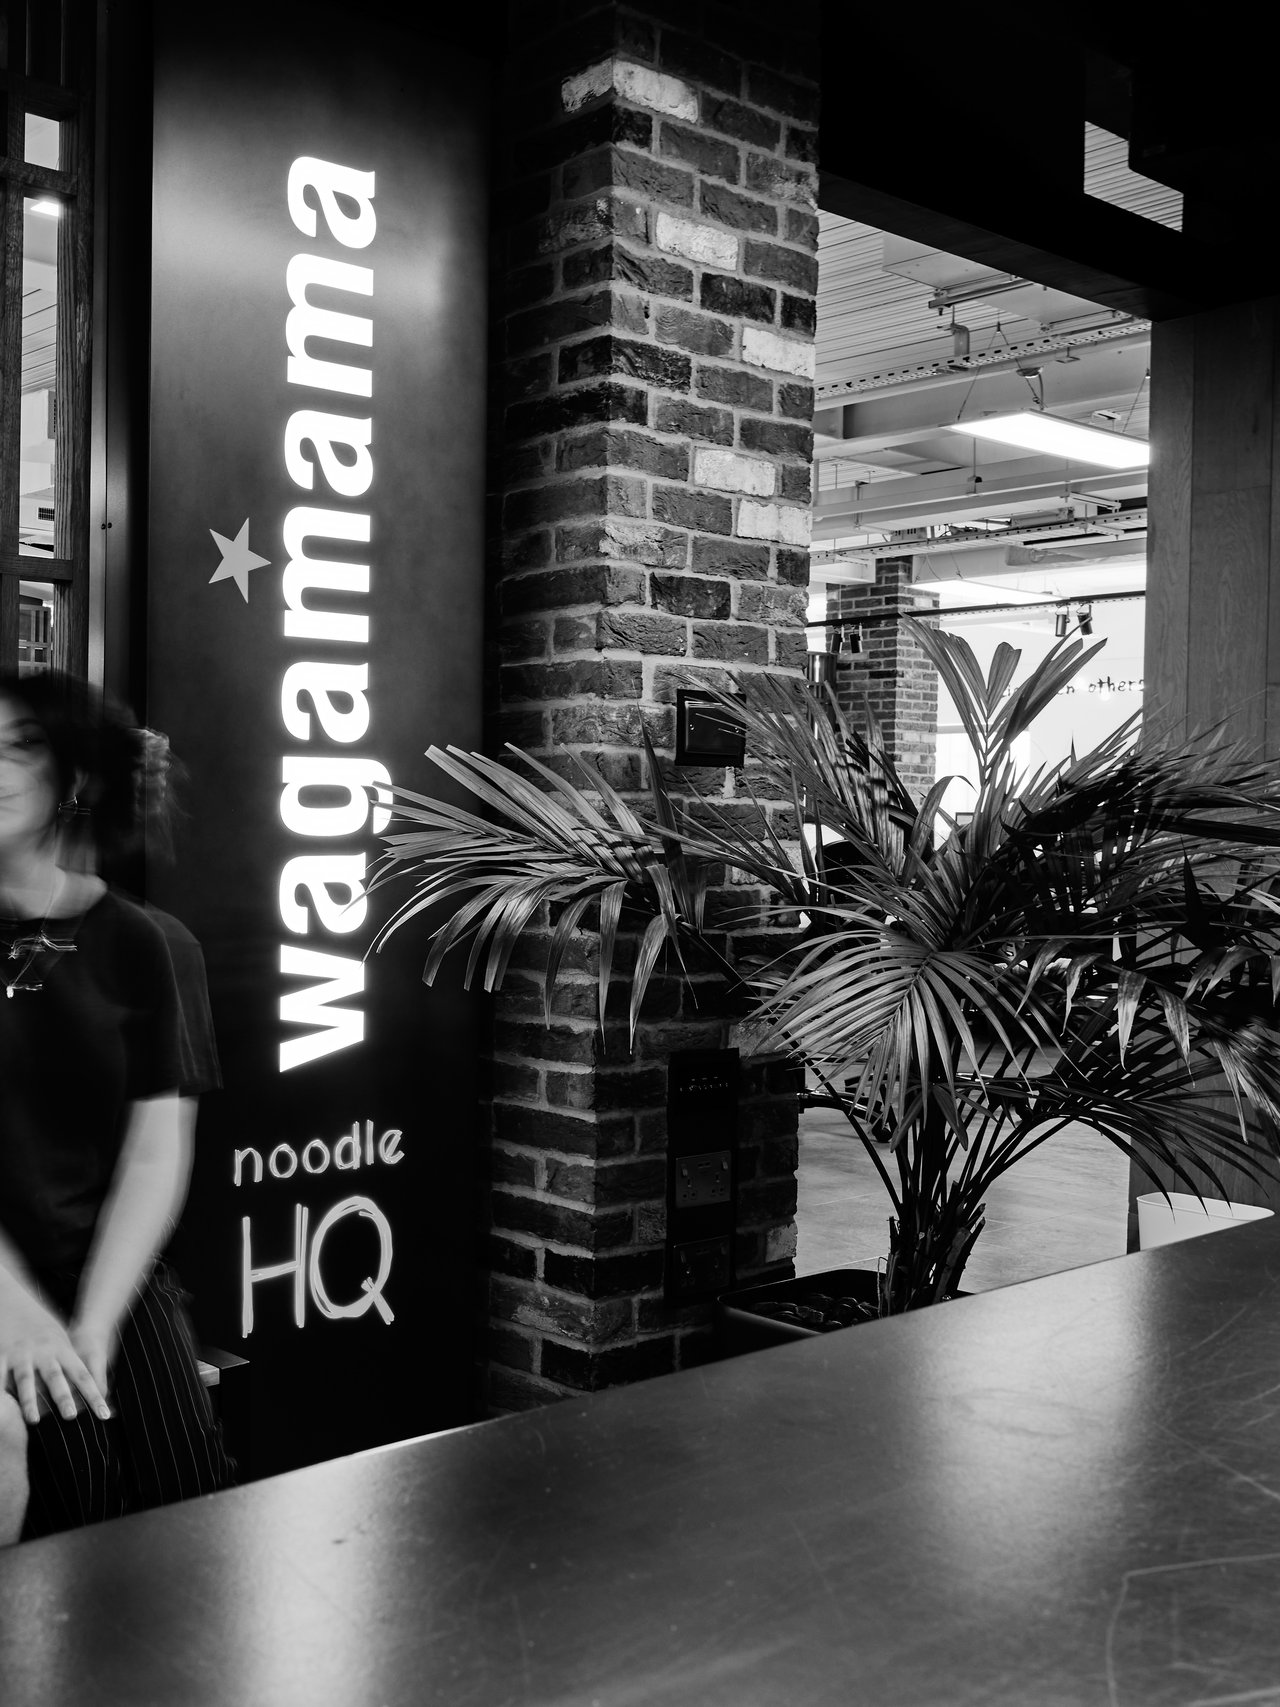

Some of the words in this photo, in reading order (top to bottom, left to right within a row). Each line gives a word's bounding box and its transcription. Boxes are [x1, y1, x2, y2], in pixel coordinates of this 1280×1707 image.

[278, 156, 395, 1074] wagamama
[233, 1119, 405, 1187] noodle
[241, 1195, 395, 1339] HQ
